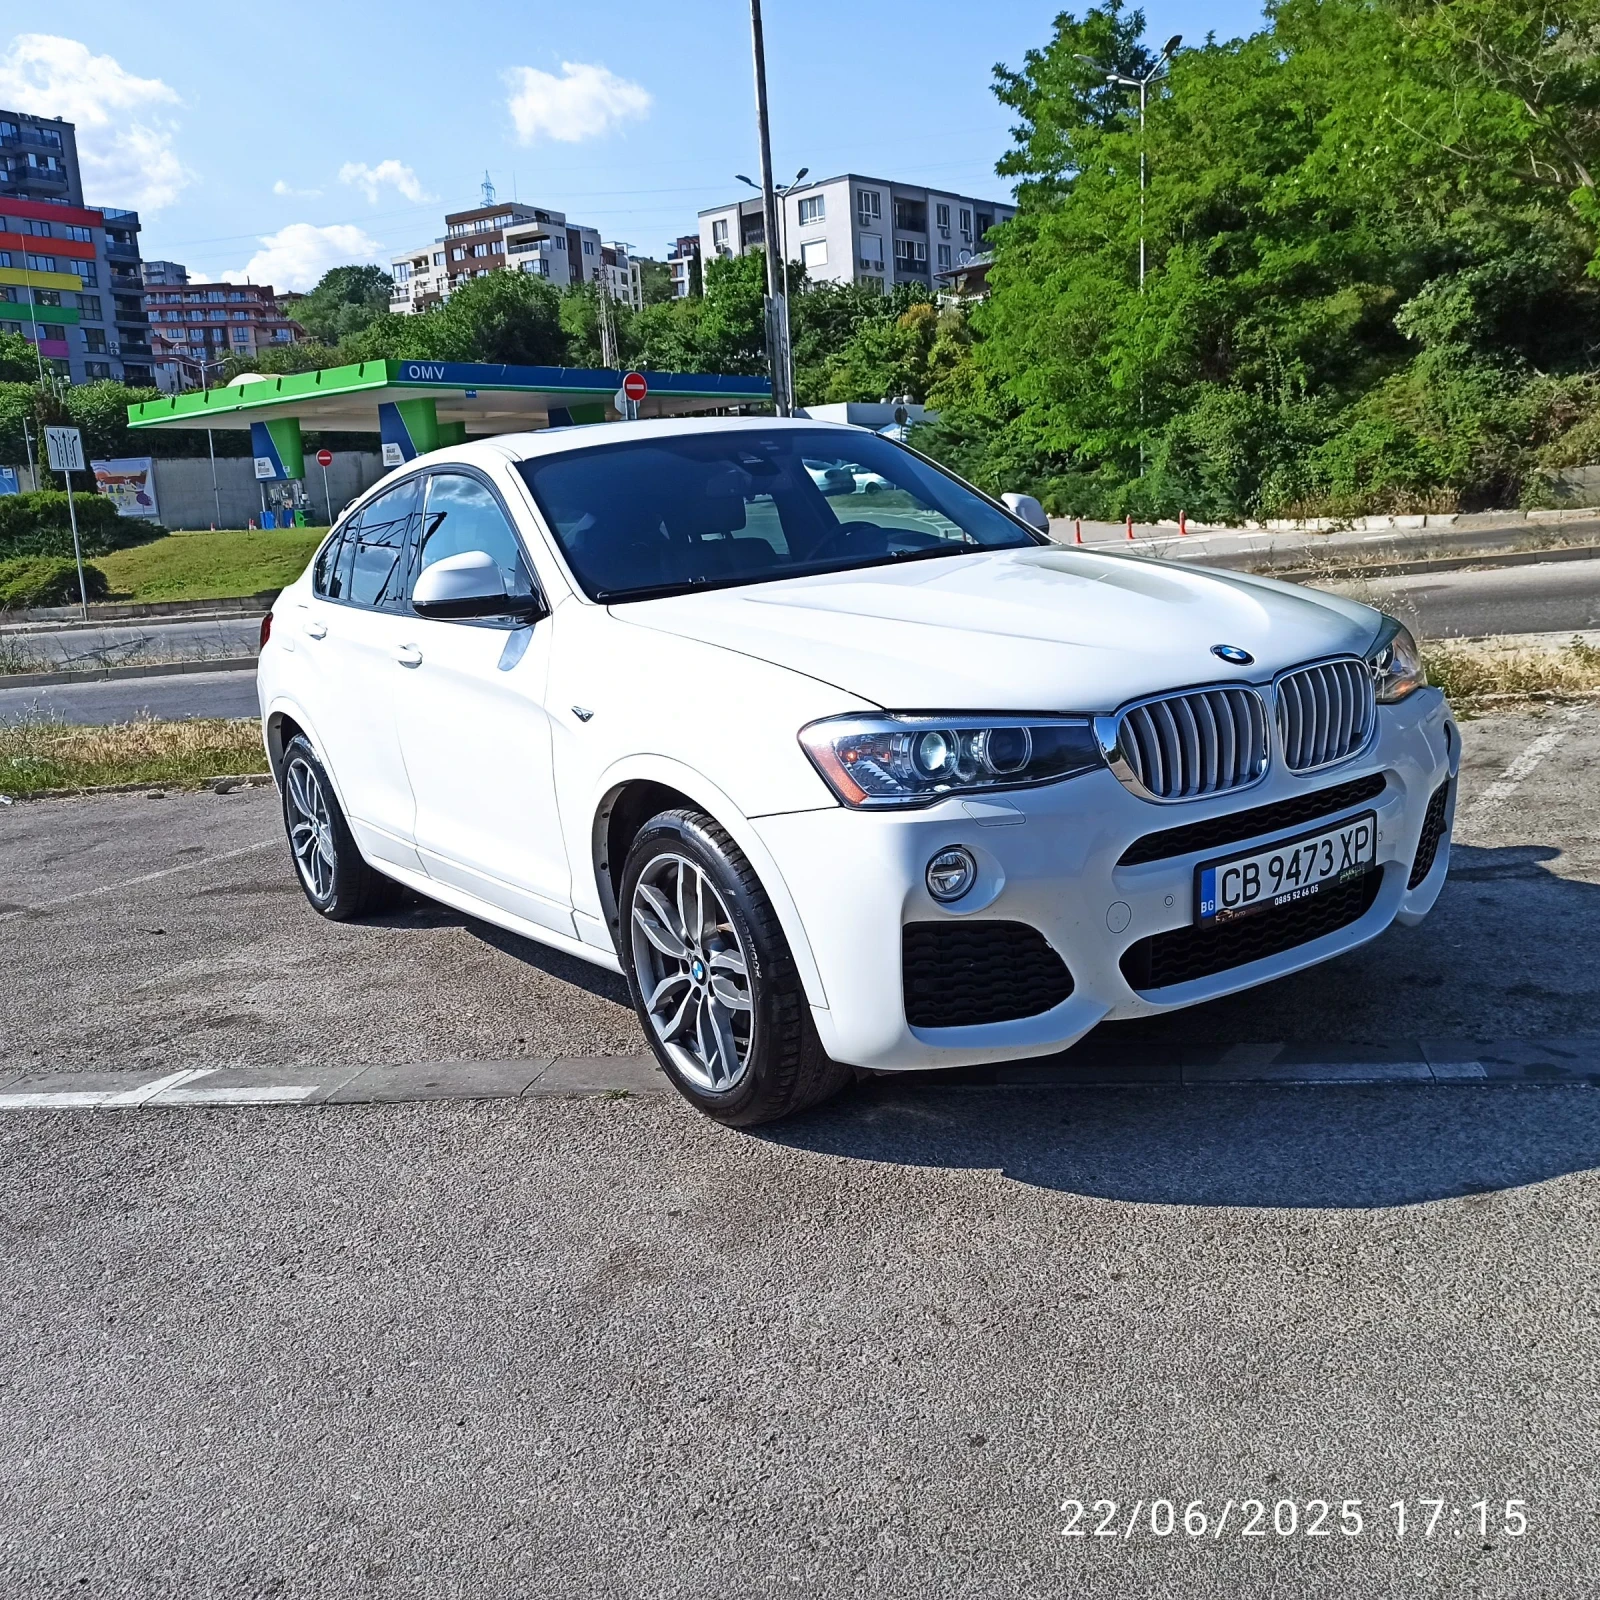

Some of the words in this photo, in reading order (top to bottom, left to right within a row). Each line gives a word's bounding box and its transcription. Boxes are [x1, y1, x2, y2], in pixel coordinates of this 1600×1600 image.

[409, 364, 445, 380] OMV
[1221, 862, 1261, 907] CB
[1268, 839, 1334, 894] 9473
[1339, 825, 1369, 870] XP
[1274, 893, 1291, 907] 0885
[1292, 890, 1301, 901] 52
[1301, 887, 1310, 898] 66
[1310, 884, 1319, 895] 05
[1201, 899, 1214, 914] BG
